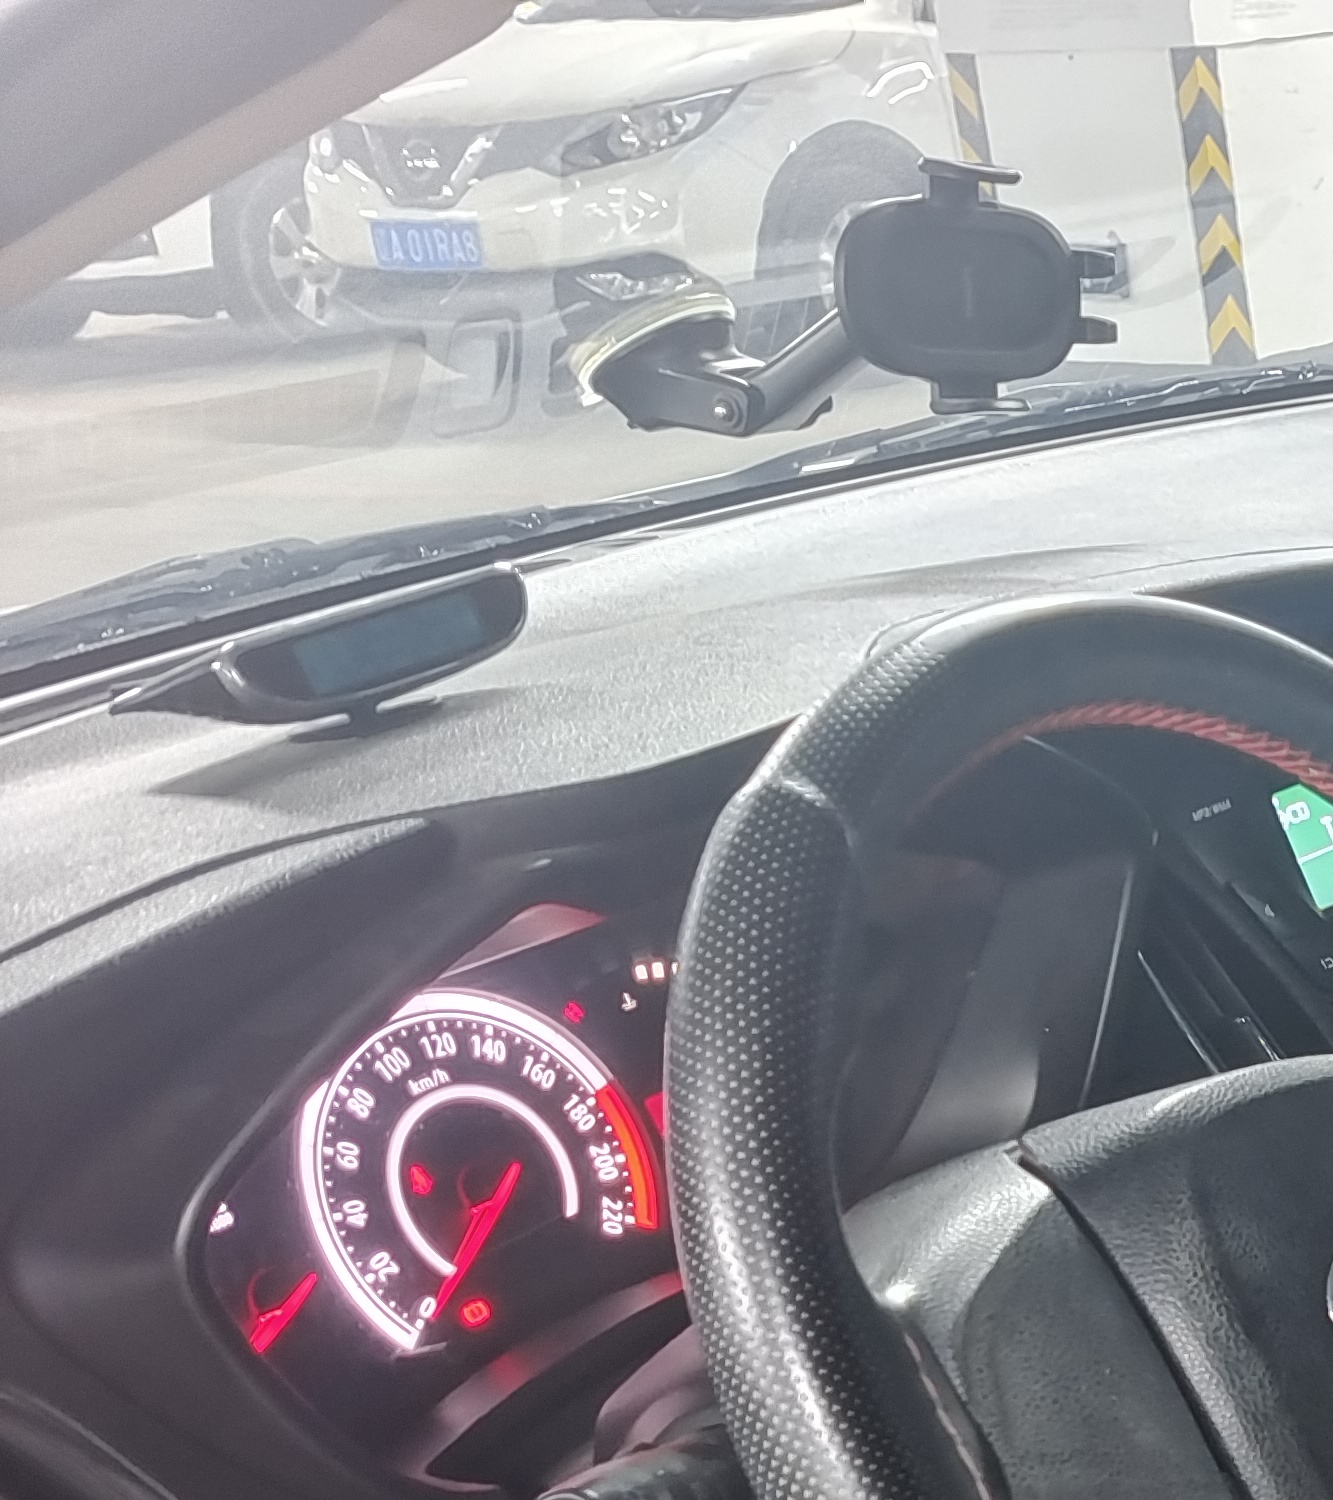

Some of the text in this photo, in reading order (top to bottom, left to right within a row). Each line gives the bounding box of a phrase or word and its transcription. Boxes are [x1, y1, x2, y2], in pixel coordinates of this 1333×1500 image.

[420, 1033, 457, 1059] 120
[471, 1035, 506, 1064] 140
[374, 1047, 411, 1082] 100
[521, 1056, 556, 1090] 160
[407, 1068, 450, 1095] km/h
[347, 1087, 375, 1119] 80
[564, 1093, 596, 1132] 180
[336, 1141, 360, 1170] 60
[589, 1143, 618, 1181] 200
[342, 1200, 368, 1228] 40
[601, 1196, 624, 1235] 220
[369, 1251, 400, 1282] 20
[418, 1297, 437, 1318] 0
